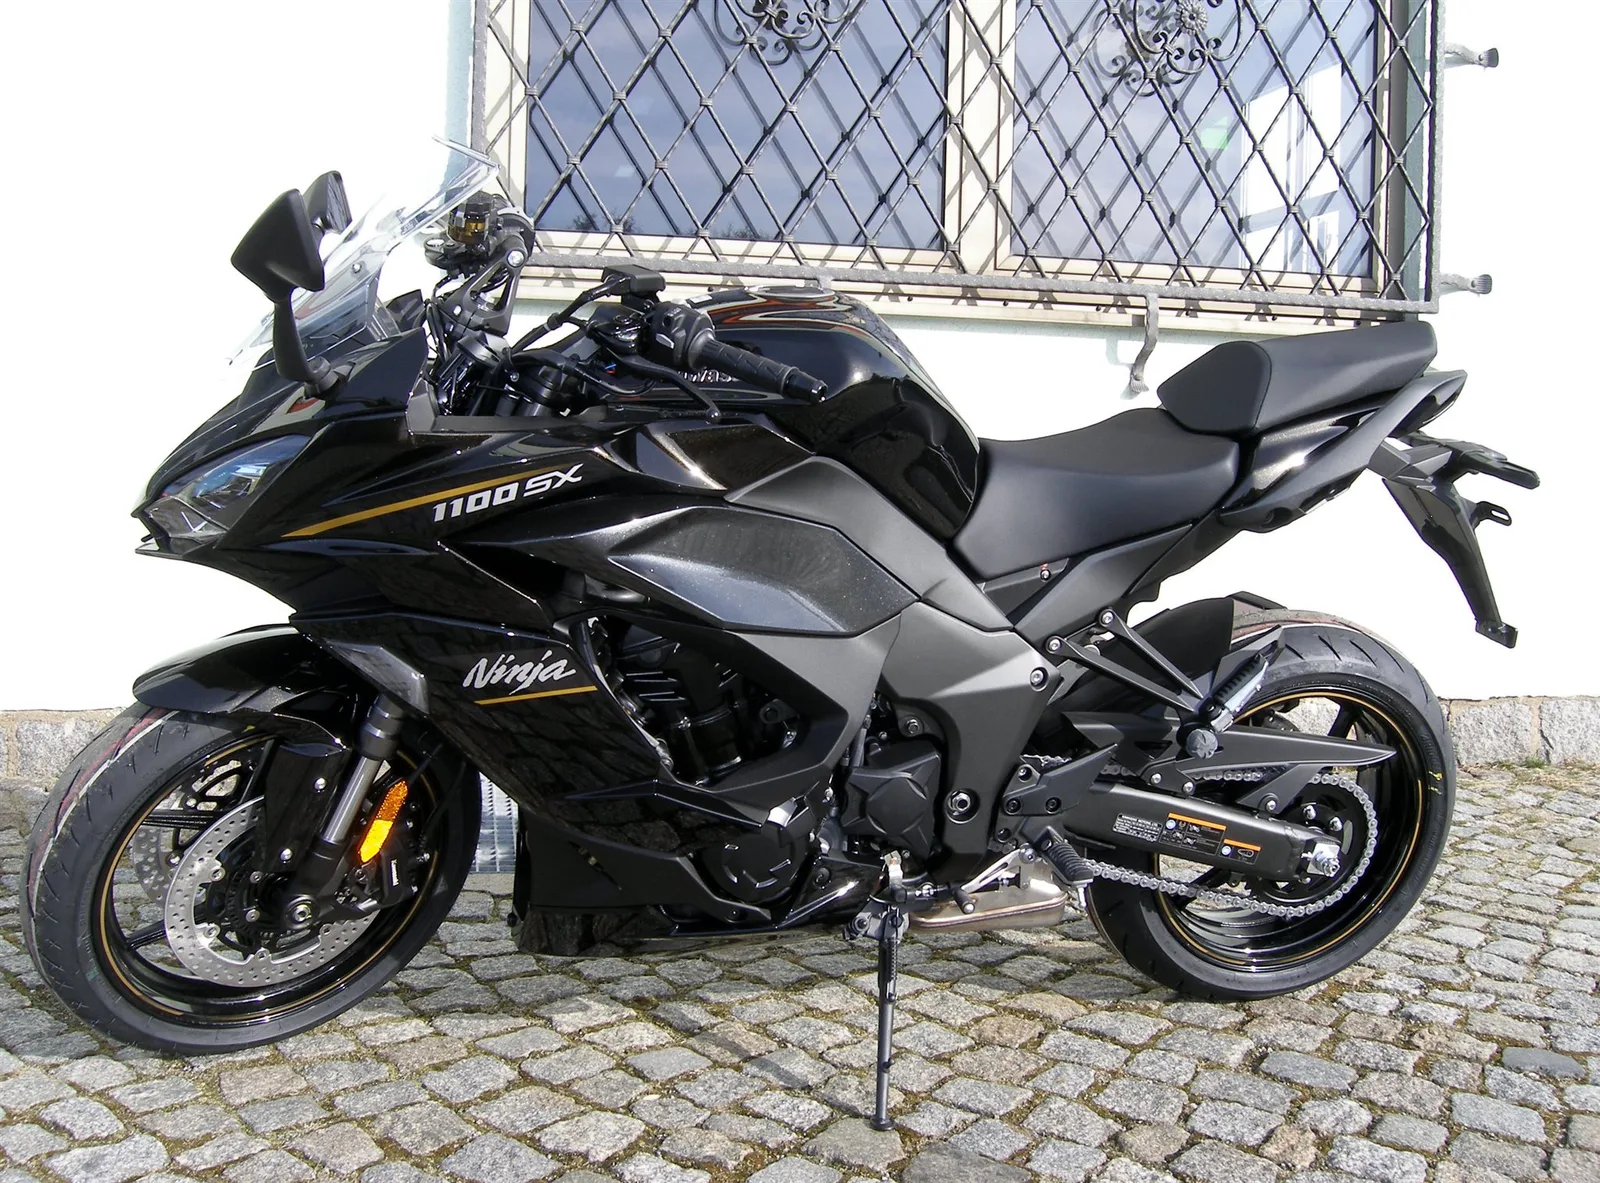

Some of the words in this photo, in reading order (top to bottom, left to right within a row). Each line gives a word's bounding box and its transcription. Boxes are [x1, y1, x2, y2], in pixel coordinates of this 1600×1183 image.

[433, 482, 519, 523] 1100
[523, 463, 584, 498] SX
[462, 649, 577, 696] Ninja
